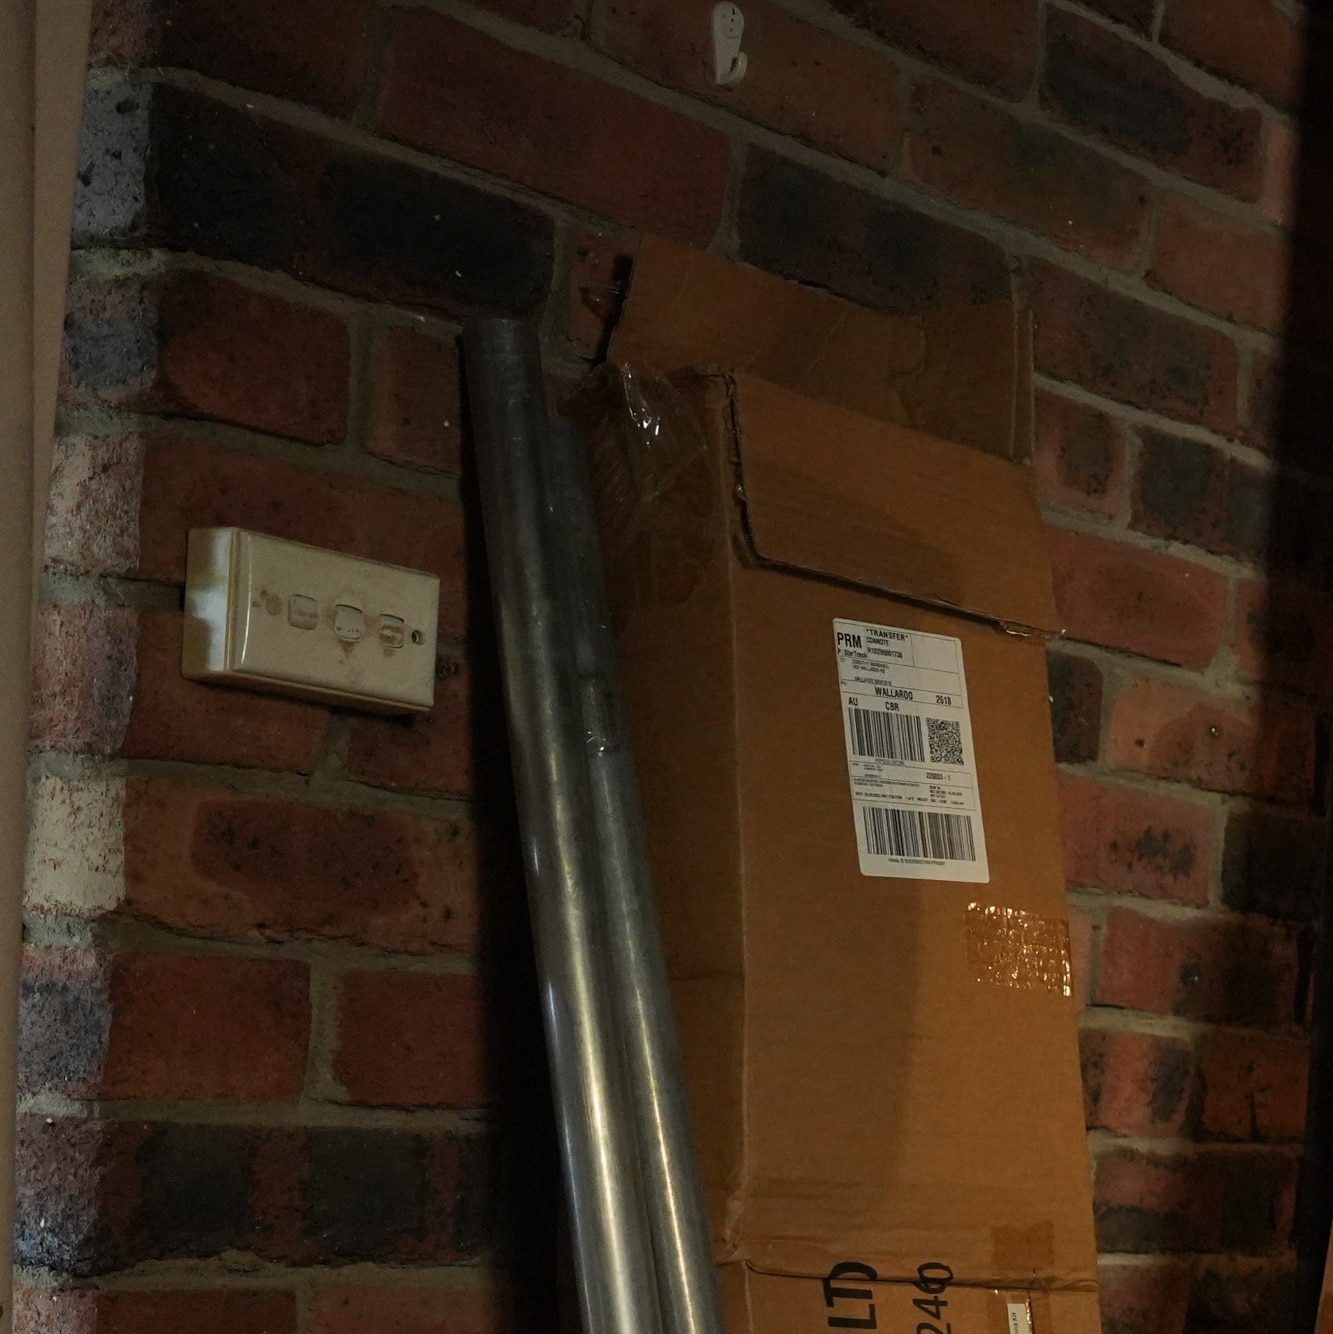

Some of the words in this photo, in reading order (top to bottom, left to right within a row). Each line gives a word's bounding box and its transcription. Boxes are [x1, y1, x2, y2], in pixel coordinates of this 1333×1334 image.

[837, 631, 863, 649] PRM
[848, 697, 859, 707] AU
[822, 1261, 879, 1331] LTD
